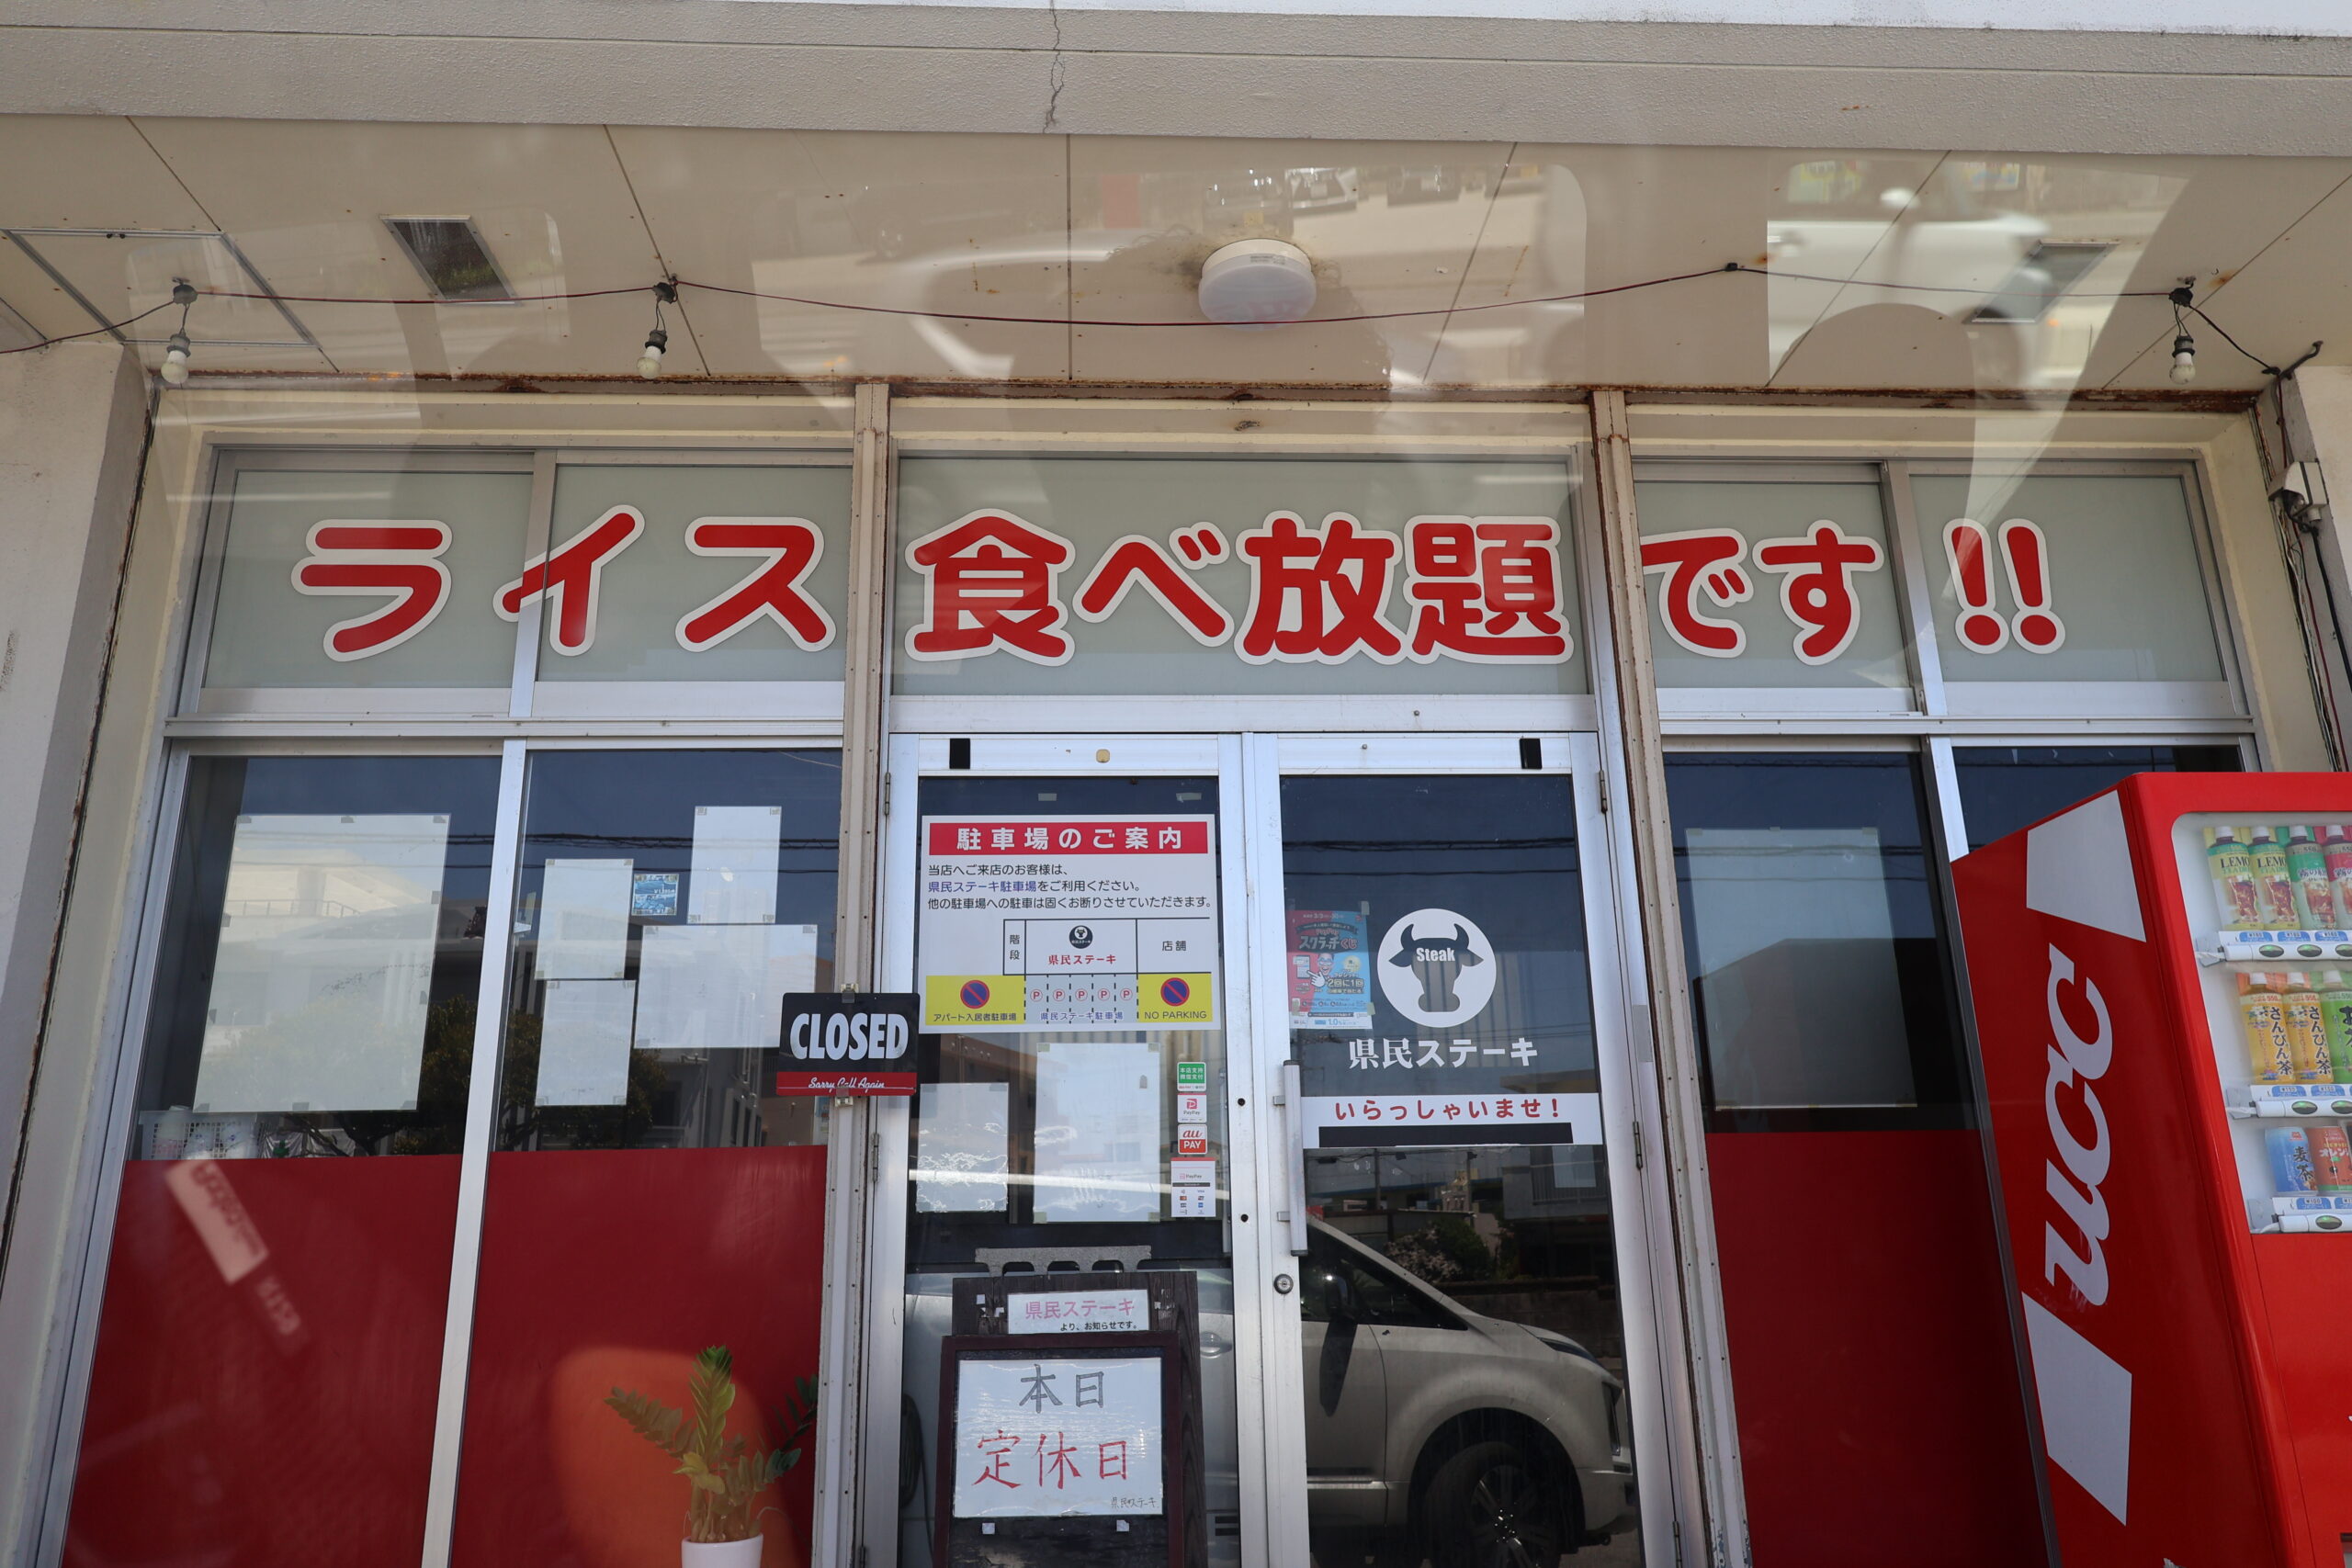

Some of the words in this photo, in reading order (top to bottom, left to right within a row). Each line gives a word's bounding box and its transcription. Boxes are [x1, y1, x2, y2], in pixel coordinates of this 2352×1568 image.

[956, 827, 1182, 851] 駐車場のご案内
[928, 863, 1069, 876] 当店へご来店のお客様は、
[928, 879, 1141, 893] 県民ステーキ駐車場をご利用ください。
[927, 896, 1211, 910] 他の駐車場への駐車は固くお断りさせていただきます。
[1009, 934, 1021, 961] 階段
[1161, 941, 1187, 952] 店舗
[1048, 953, 1116, 965] 県民ステーキ
[1416, 947, 1456, 962] Steak
[933, 1012, 1017, 1021] アパート入居者駐車場
[1040, 1011, 1124, 1021] 県民ステーキ駐車場
[1144, 1011, 1159, 1020] NO
[1162, 1010, 1207, 1019] PARKING
[790, 1012, 909, 1061] CLOSED
[1349, 1037, 1538, 1070] 県民ステーキ
[808, 1077, 835, 1092] Sorry
[858, 1077, 885, 1092] Again
[1335, 1099, 1559, 1121] いらっしゃいませ!
[1182, 1130, 1203, 1138] au
[1183, 1141, 1202, 1149] PAY
[2293, 1146, 2314, 1181] 麦茶
[1025, 1298, 1135, 1319] 県民ステーキ
[1060, 1320, 1137, 1332] より、お知らせです。
[1019, 1363, 1104, 1414] 本日
[972, 1429, 1128, 1490] 定休日
